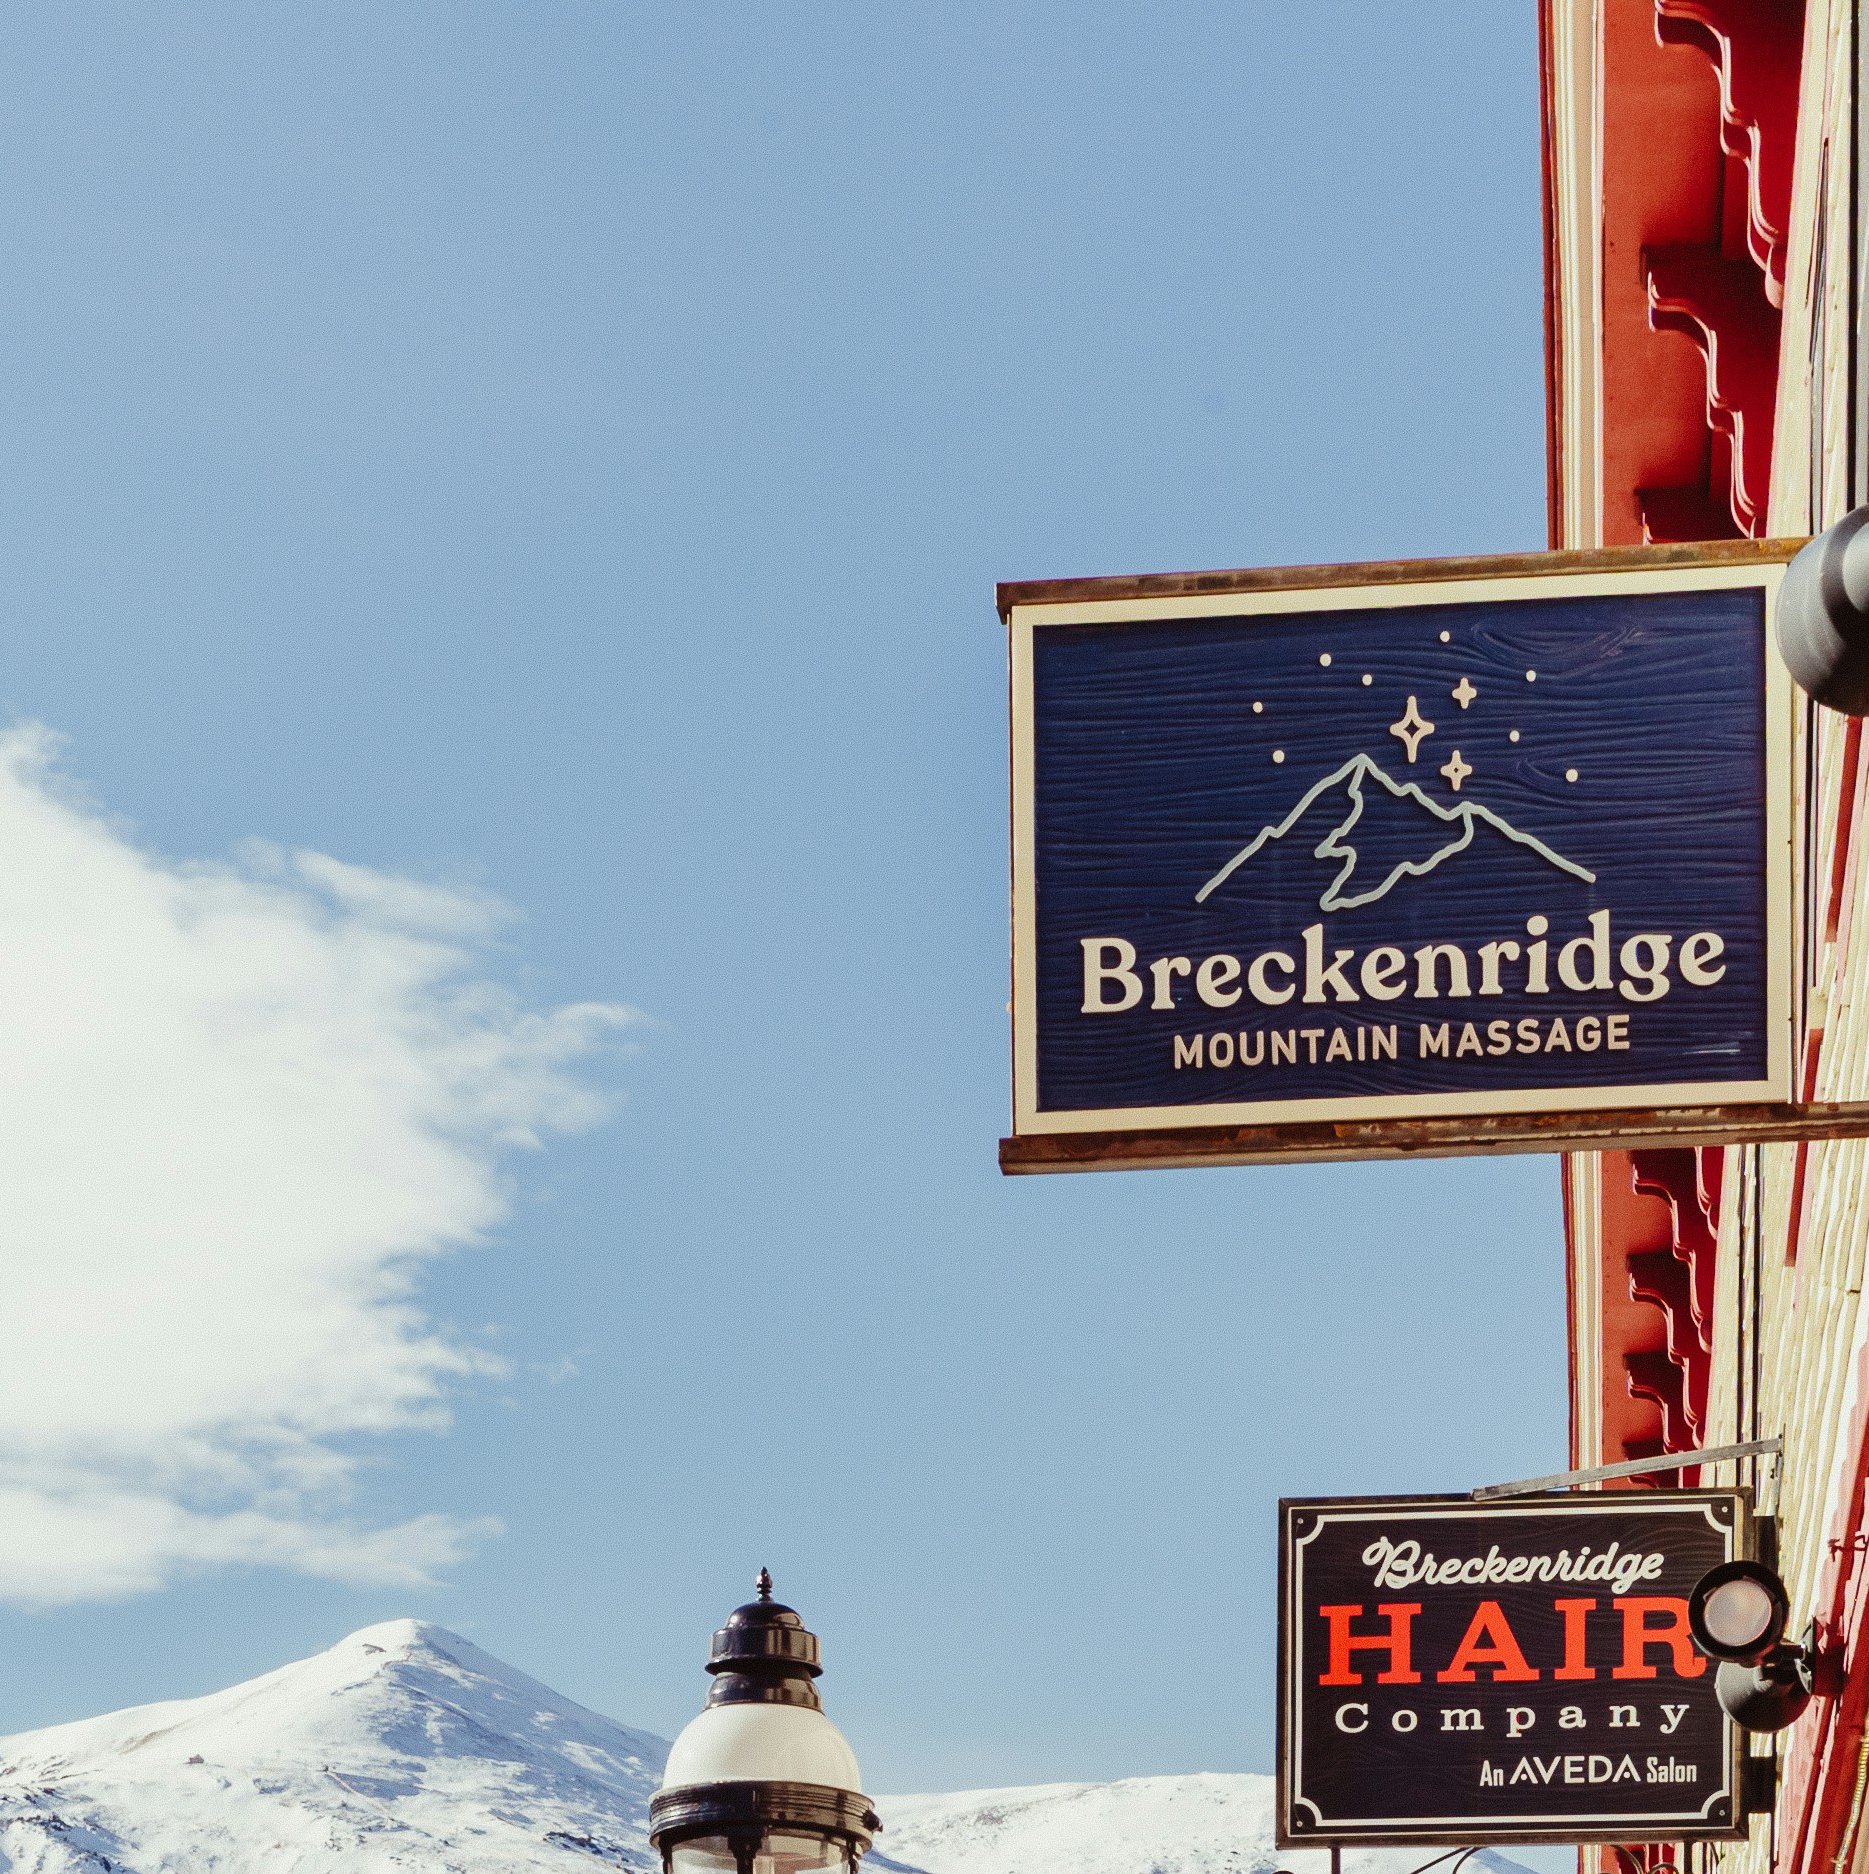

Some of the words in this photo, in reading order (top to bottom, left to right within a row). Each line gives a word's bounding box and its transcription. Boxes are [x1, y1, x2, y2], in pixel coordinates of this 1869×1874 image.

[1079, 908, 1727, 1015] Breckenridge
[1173, 1024, 1398, 1070] MOUNTAIN
[1419, 1014, 1631, 1059] MASSAGE
[1361, 1535, 1665, 1595] Breckenridge
[1318, 1596, 1708, 1686] HAIR
[1334, 1702, 1690, 1738] Company
[1479, 1759, 1504, 1787] An
[1509, 1753, 1642, 1785] AVEDA
[1646, 1752, 1697, 1783] Salon
